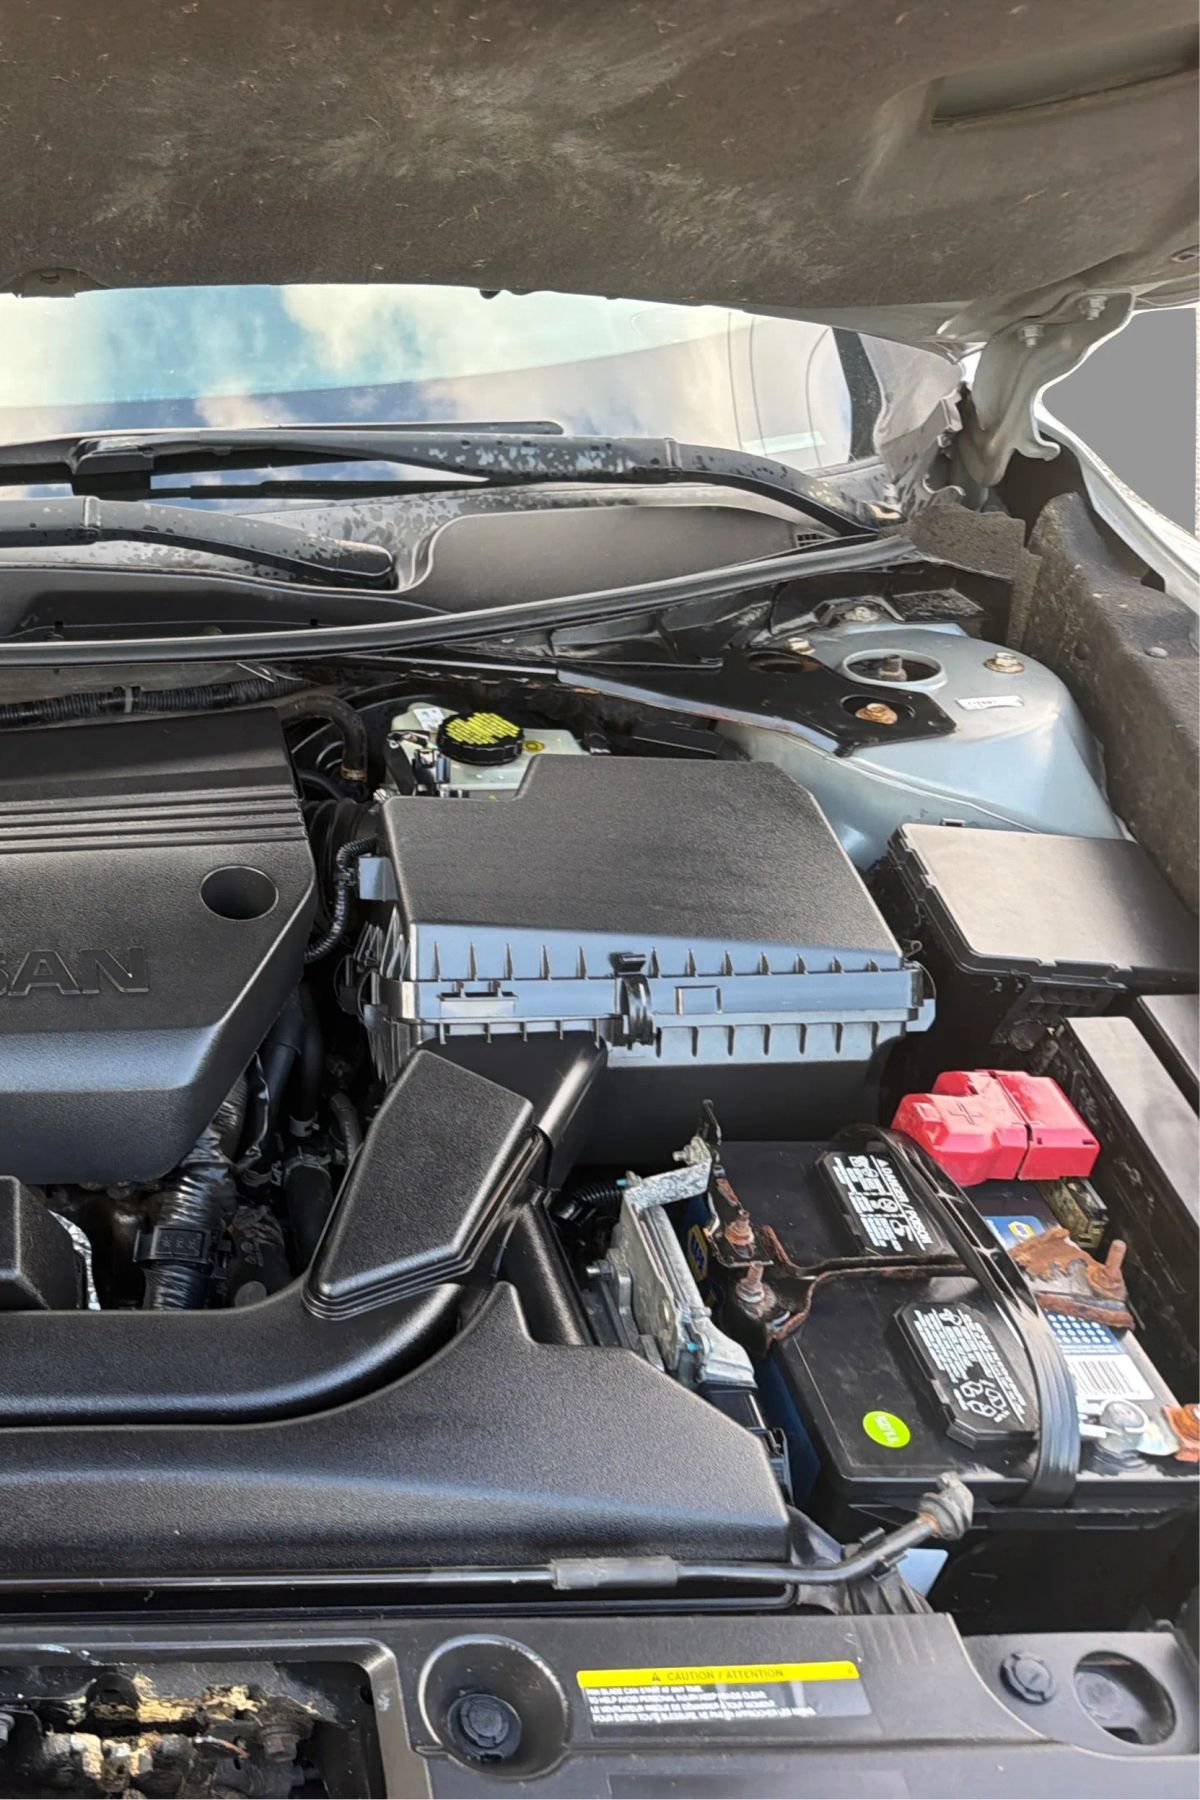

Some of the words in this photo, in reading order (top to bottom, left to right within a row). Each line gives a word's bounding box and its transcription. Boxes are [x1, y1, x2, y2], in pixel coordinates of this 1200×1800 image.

[881, 1168, 910, 1203] DANGER
[904, 1209, 934, 1244] POISON
[667, 1670, 715, 1681] CAUTION
[726, 1668, 784, 1679] ATTENTION
